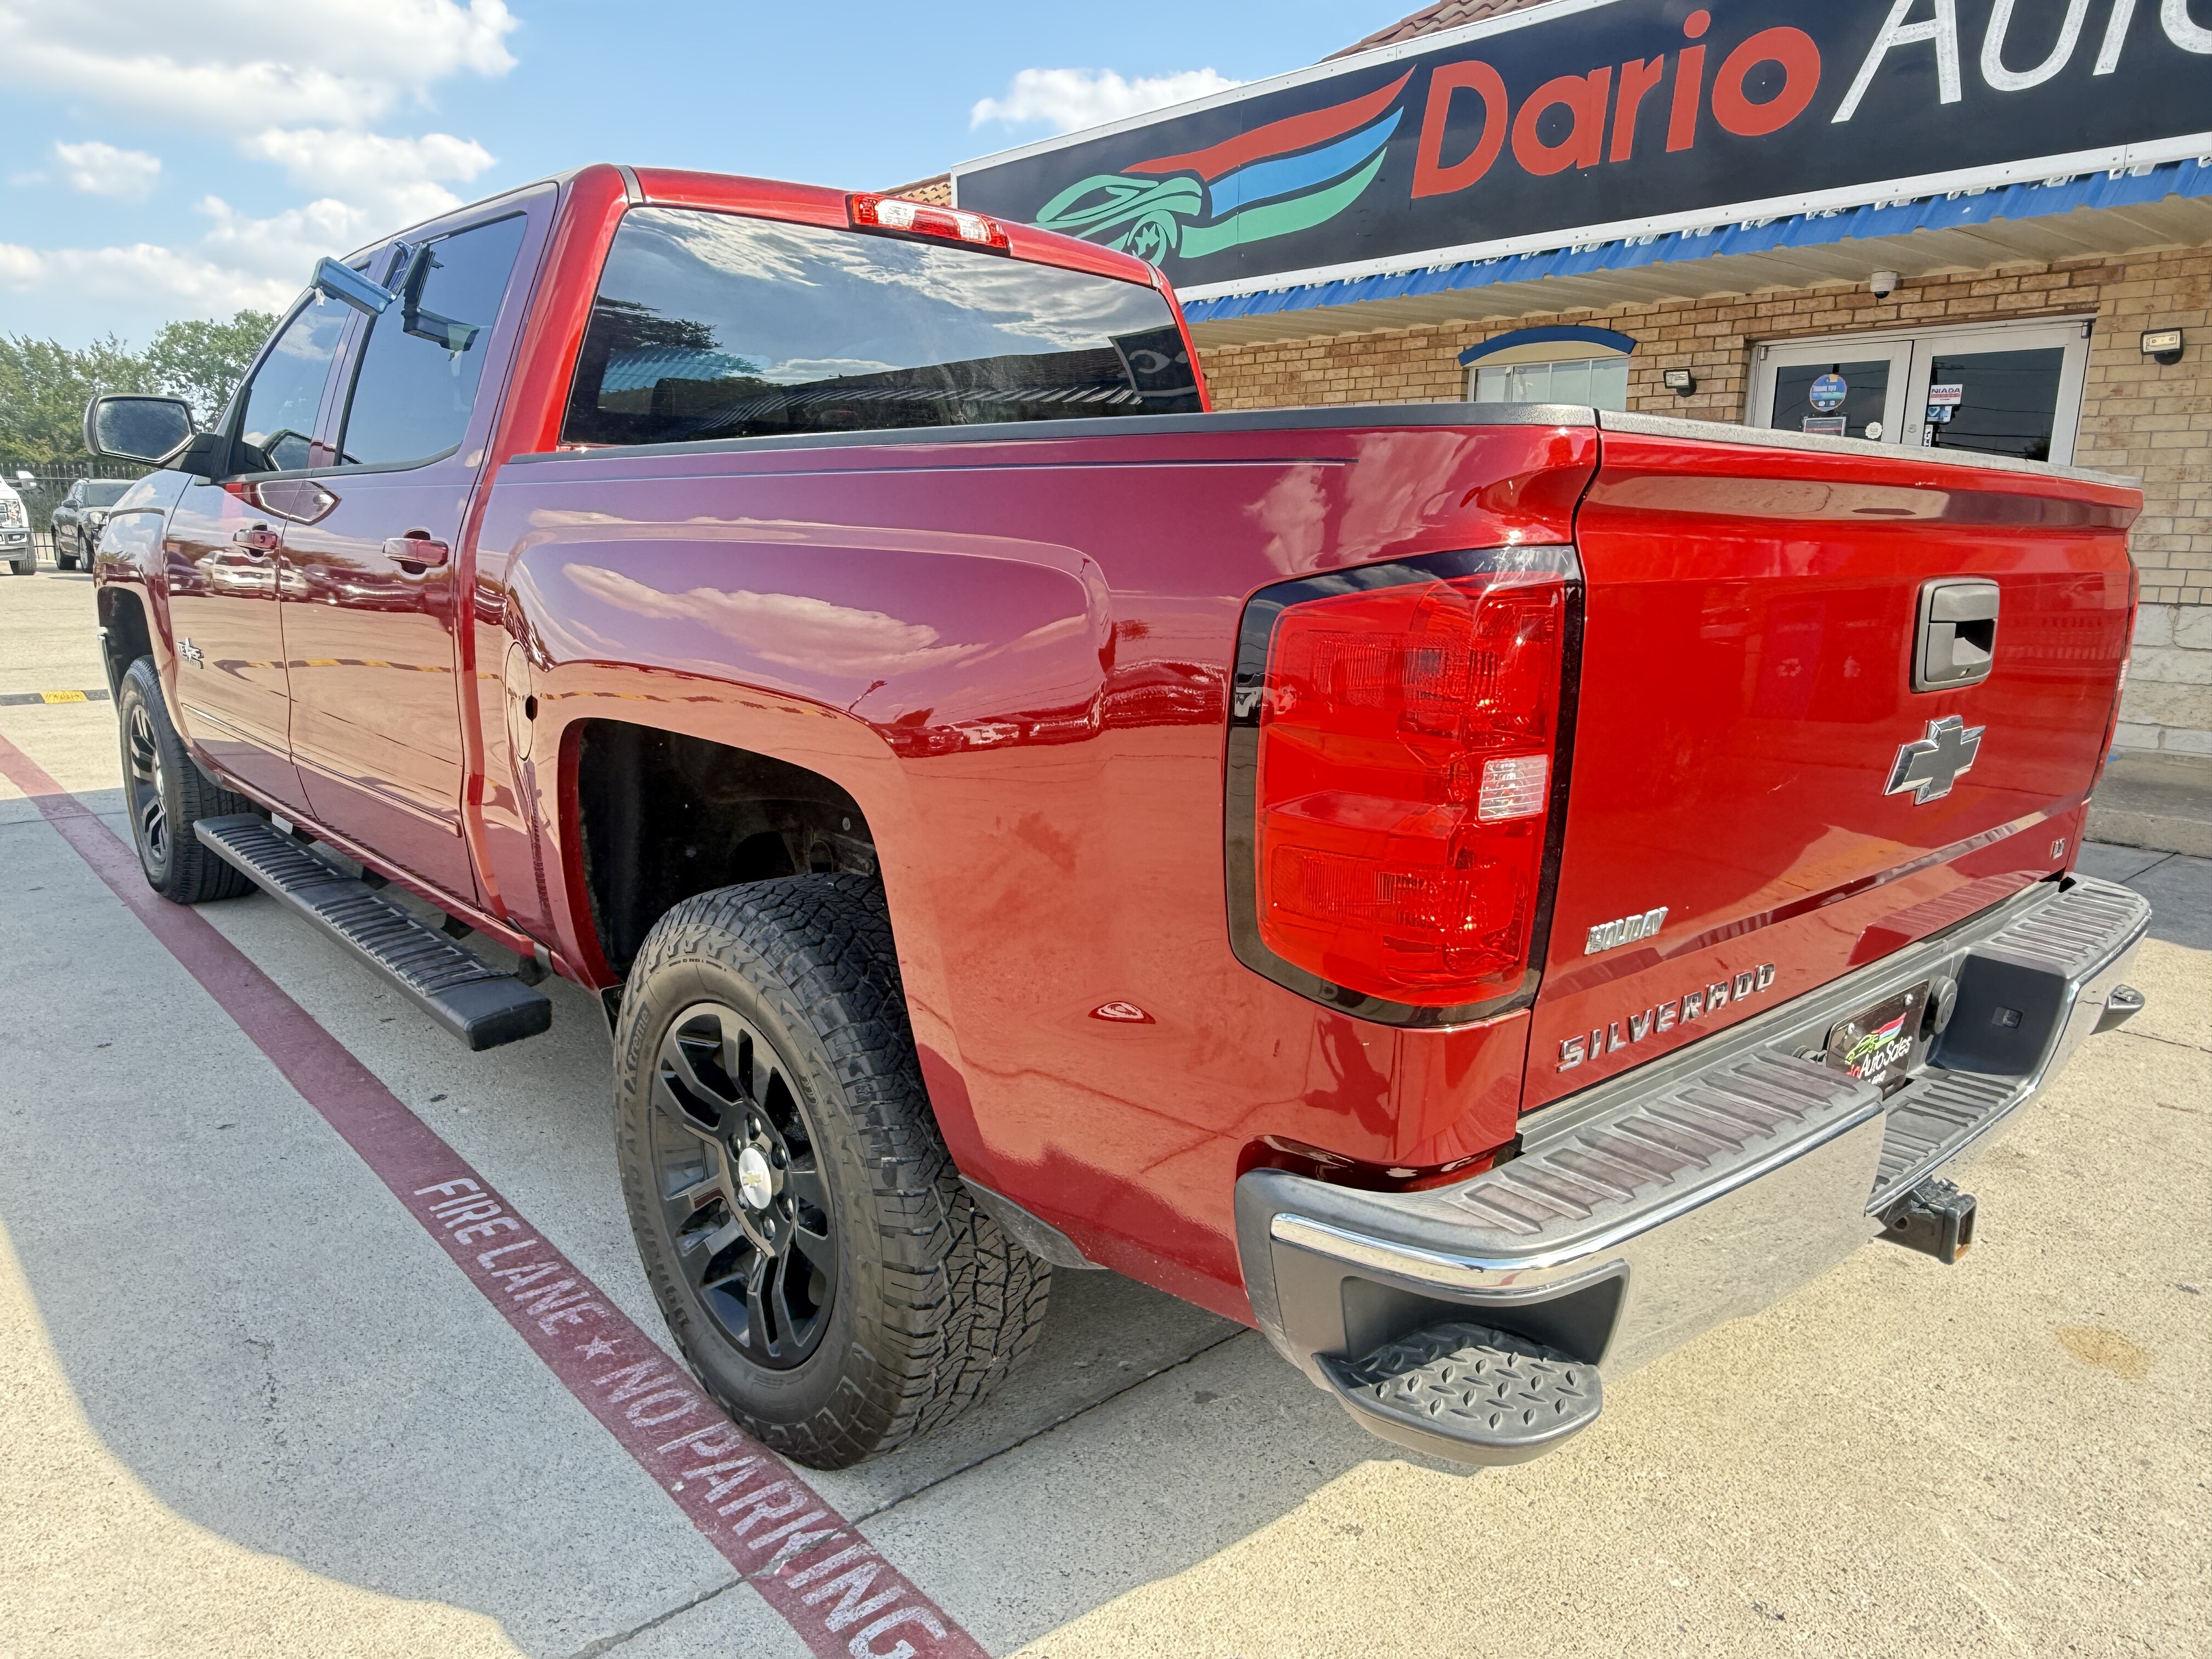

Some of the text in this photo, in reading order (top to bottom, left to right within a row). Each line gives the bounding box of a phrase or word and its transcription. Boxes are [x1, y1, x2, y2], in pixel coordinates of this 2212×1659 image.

[1411, 9, 1821, 199] Dario
[1556, 963, 1775, 1073] SILVERADO
[414, 1178, 946, 1659] FIRE LANE NO PARKING
